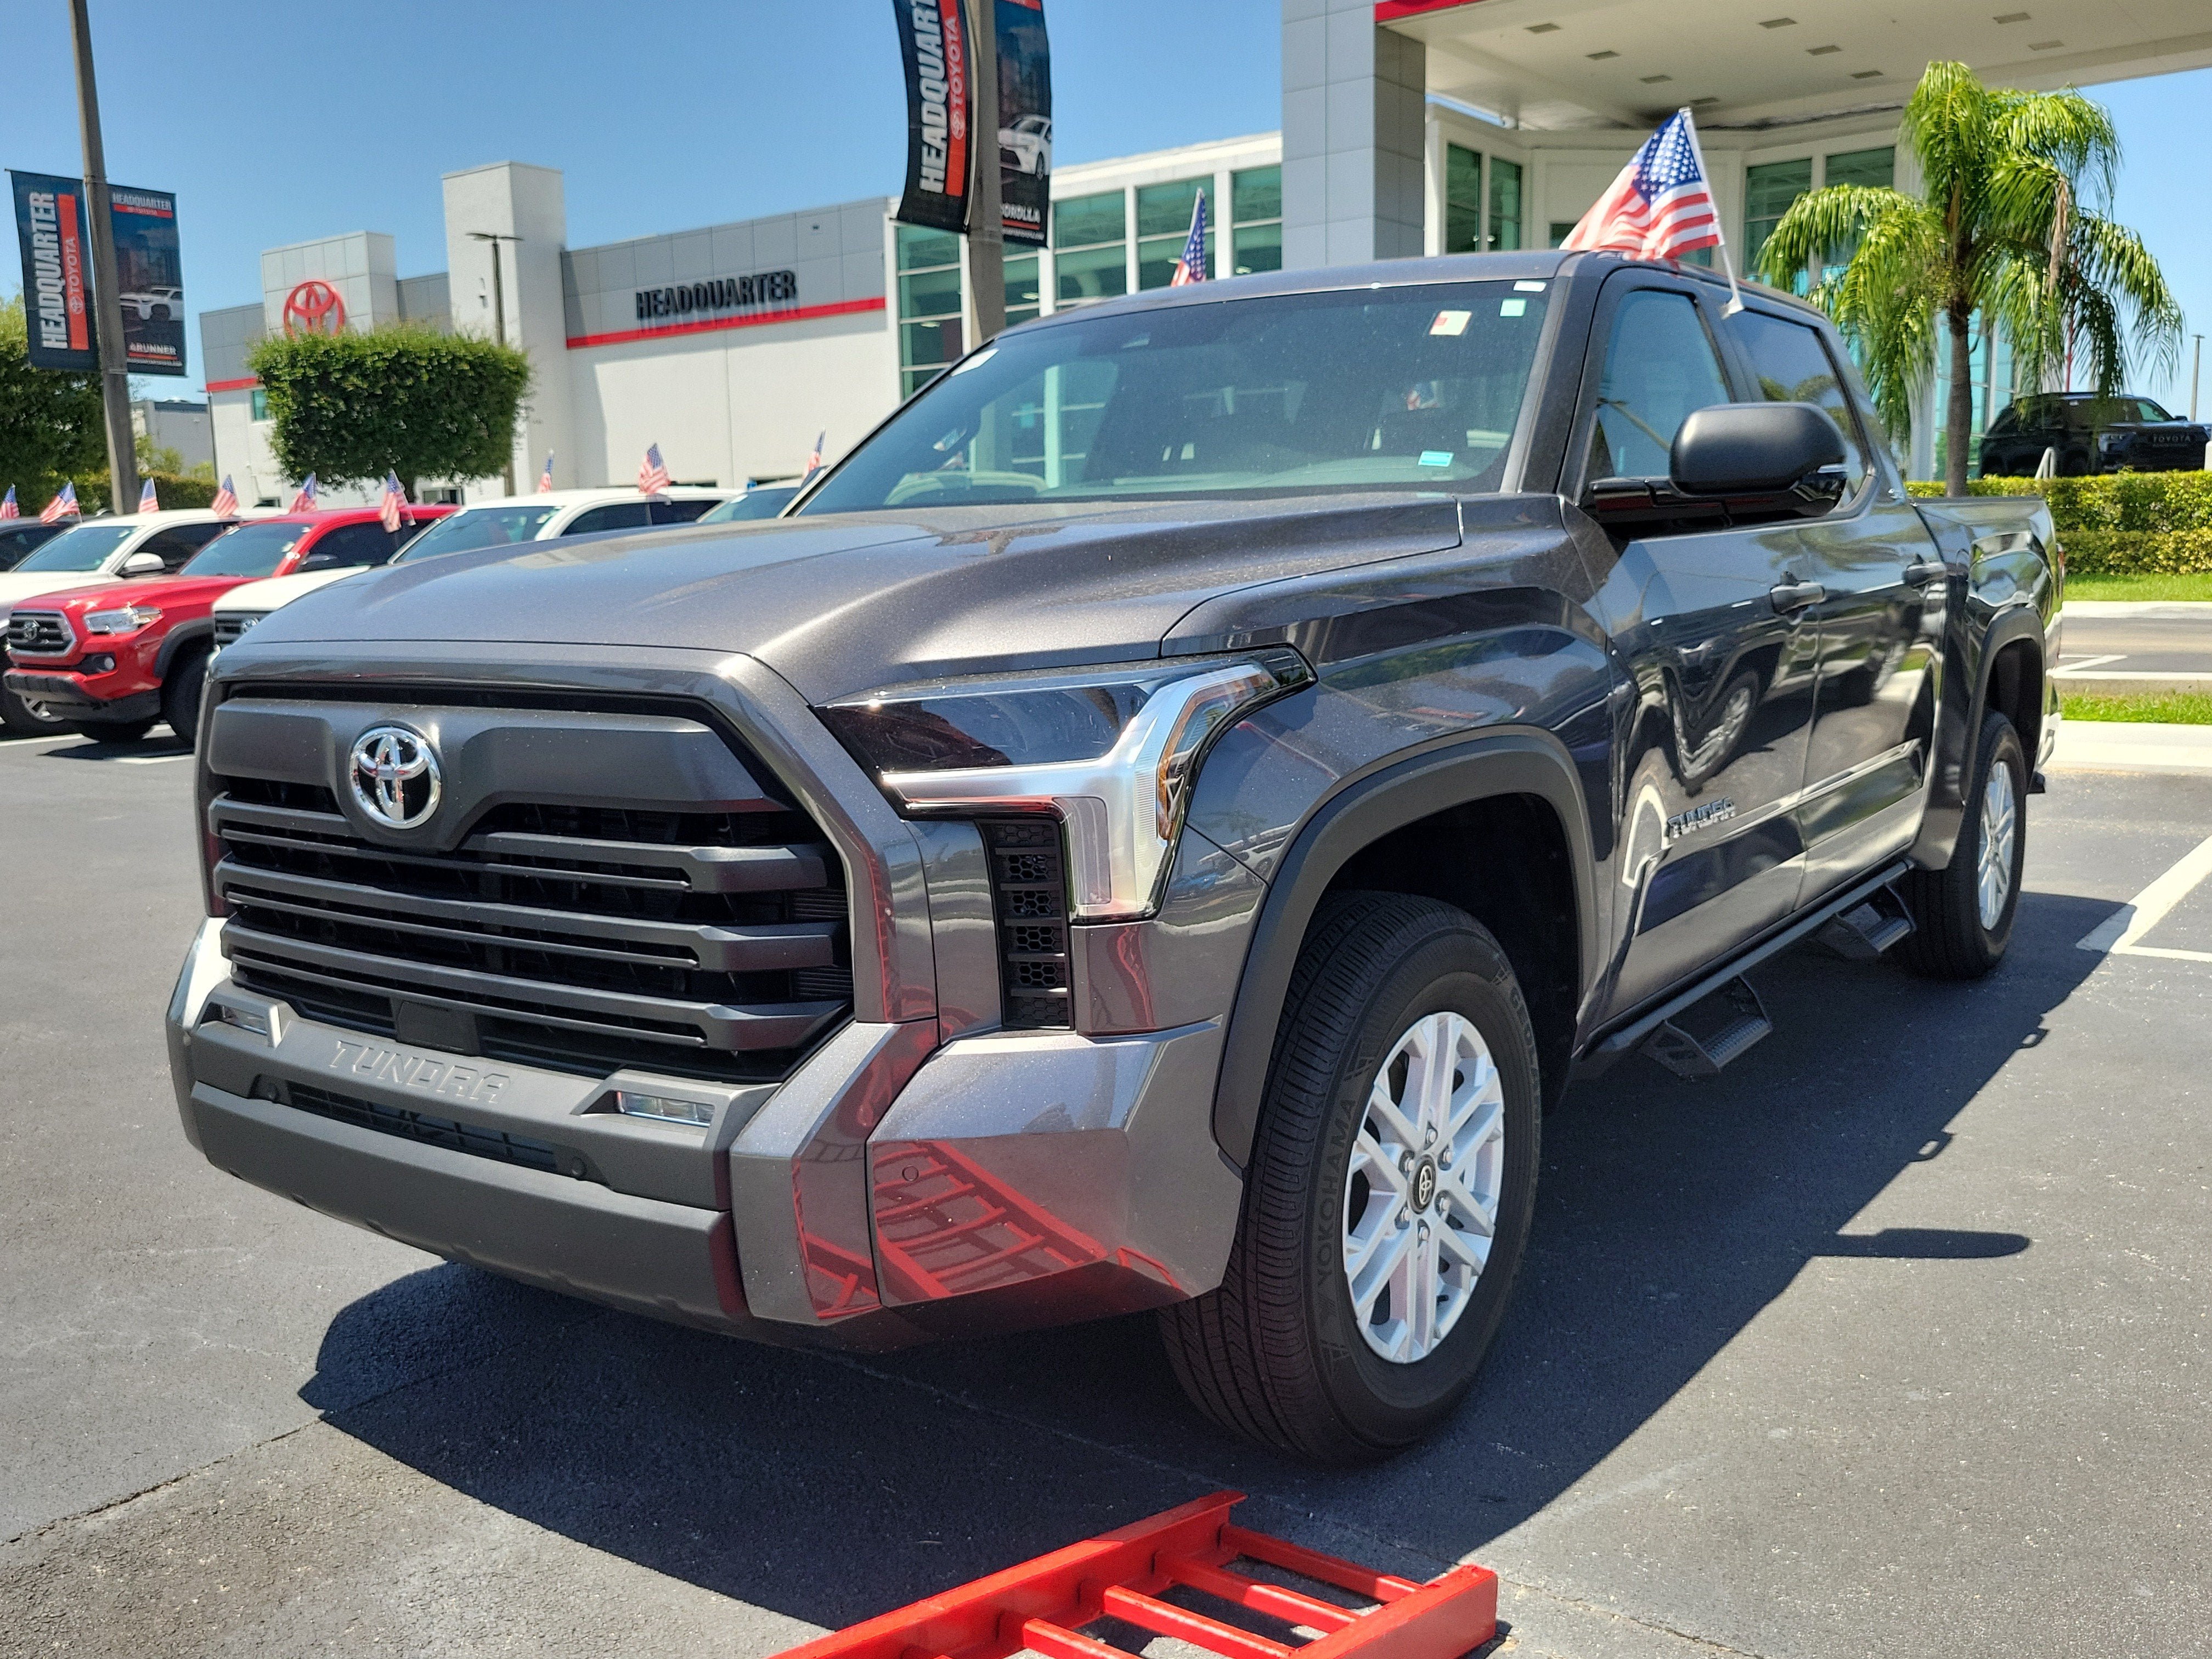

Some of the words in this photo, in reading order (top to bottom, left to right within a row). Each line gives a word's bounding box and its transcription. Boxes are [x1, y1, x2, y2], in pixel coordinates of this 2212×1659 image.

[944, 16, 963, 108] TOYOTA
[30, 191, 68, 350] HEADQUARTER
[65, 237, 80, 293] TOYOTA
[636, 270, 797, 320] HEADQUARTER
[2152, 433, 2191, 442] TOYOTA
[329, 1040, 510, 1104] TUNDRA
[1316, 1098, 1356, 1287] YOKOHAMA
